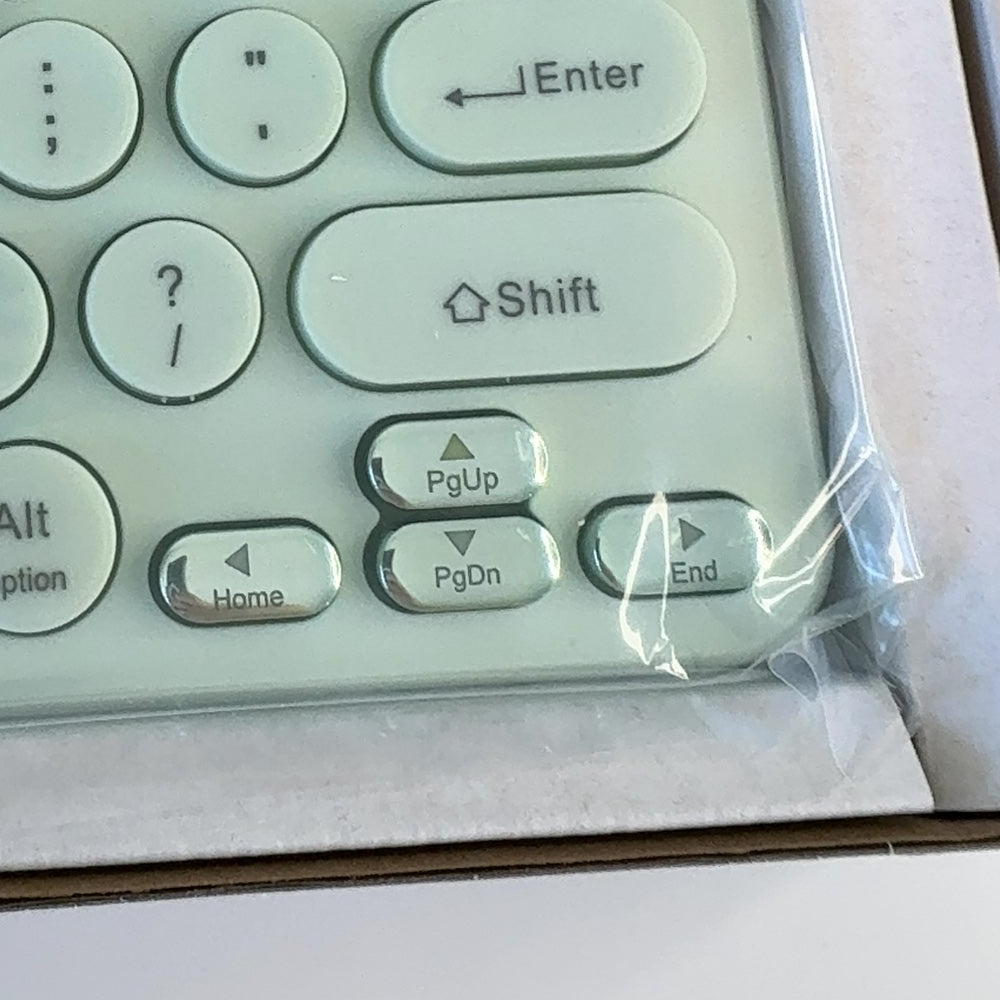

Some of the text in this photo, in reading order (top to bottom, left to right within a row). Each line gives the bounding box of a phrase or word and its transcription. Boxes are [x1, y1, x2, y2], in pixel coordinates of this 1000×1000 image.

[536, 60, 645, 94] Enter
[157, 264, 184, 307] ?
[497, 277, 600, 318] Shift
[426, 469, 499, 497] PgUp
[434, 564, 502, 591] PgDn
[671, 558, 718, 584] End
[213, 587, 285, 610] Home
